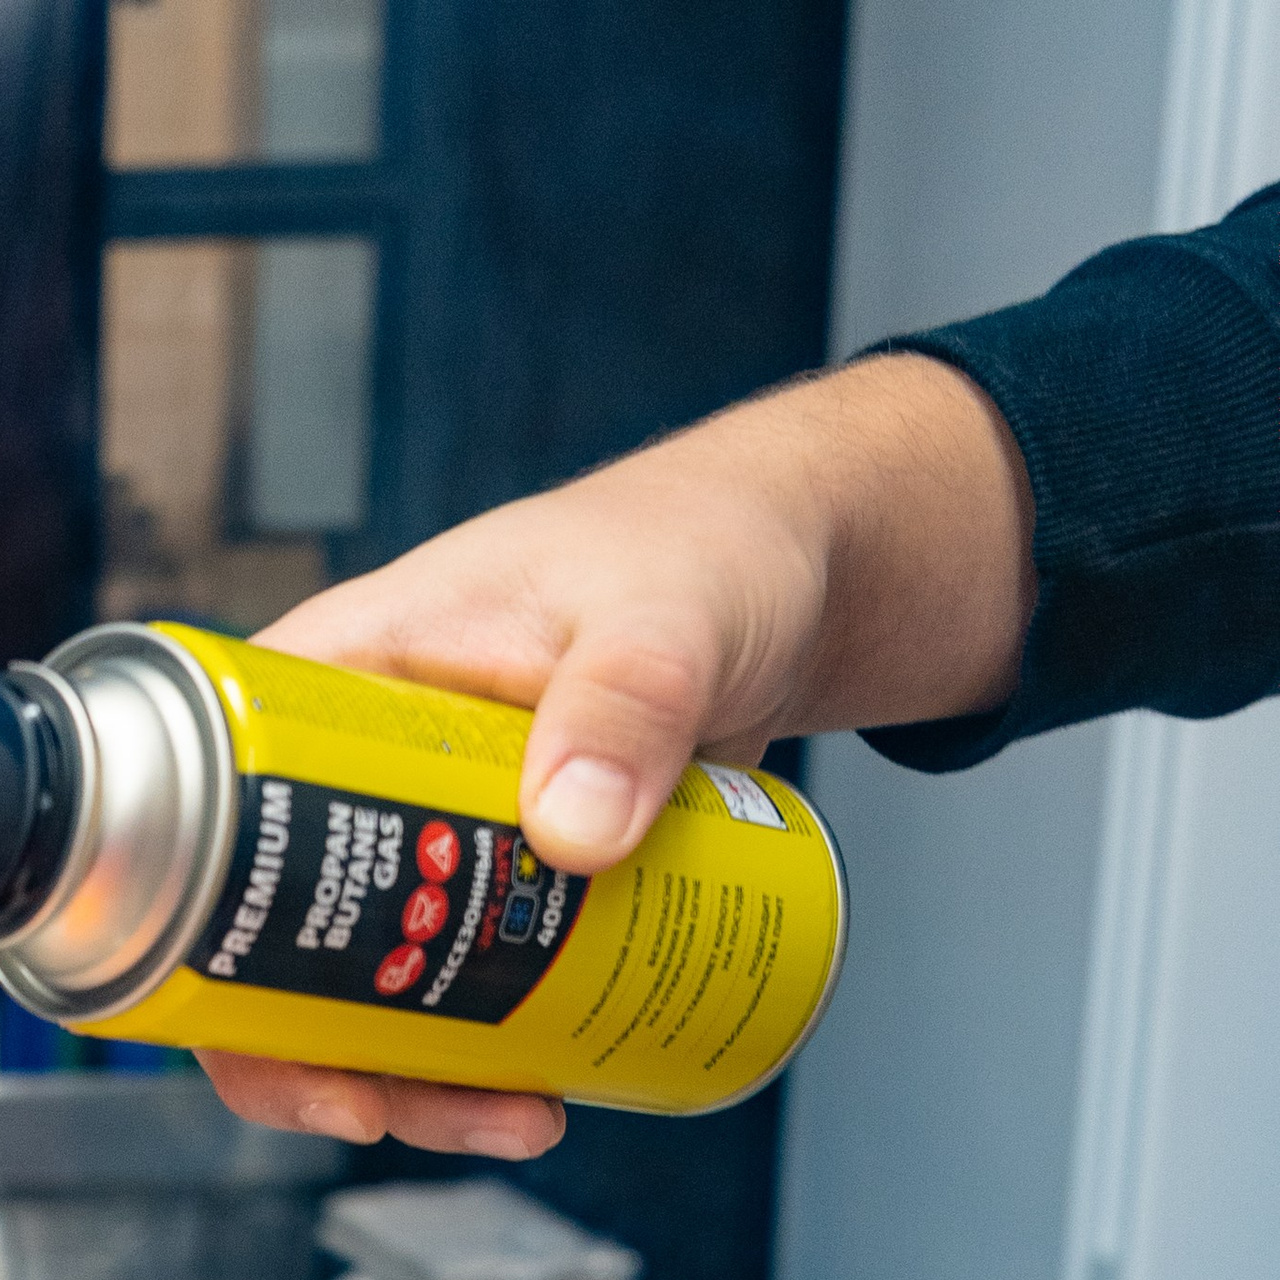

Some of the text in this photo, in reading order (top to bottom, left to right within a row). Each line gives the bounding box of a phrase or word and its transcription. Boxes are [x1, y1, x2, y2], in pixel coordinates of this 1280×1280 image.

[208, 781, 292, 977] PREMIUM
[295, 801, 353, 949] PROPAN
[323, 806, 379, 950] BUTANE
[373, 812, 404, 891] GAS
[422, 827, 494, 1007] ВСЕСЕЗОННЫЙ
[648, 872, 673, 967] БЕЗОПАСНО
[572, 866, 643, 1039] ГАЗ ВЫСОКОЙ ОЧИСТКИ
[592, 875, 687, 1068] ДЛЯ ПРИГОТОВЛЕНИЯ ПИЩИ
[646, 879, 701, 1028] НА ОТКРЫТОМ ОГНЕ
[660, 884, 729, 1049] НЕ ОСТАВЛЯЕТ КОПОТИ
[703, 896, 784, 1071] ДЛЯ БОЛЬШИНСТВА ПЛИТ
[722, 885, 744, 971] НА ПОСУДЕ
[748, 893, 770, 978] ПОДХОДИТ
